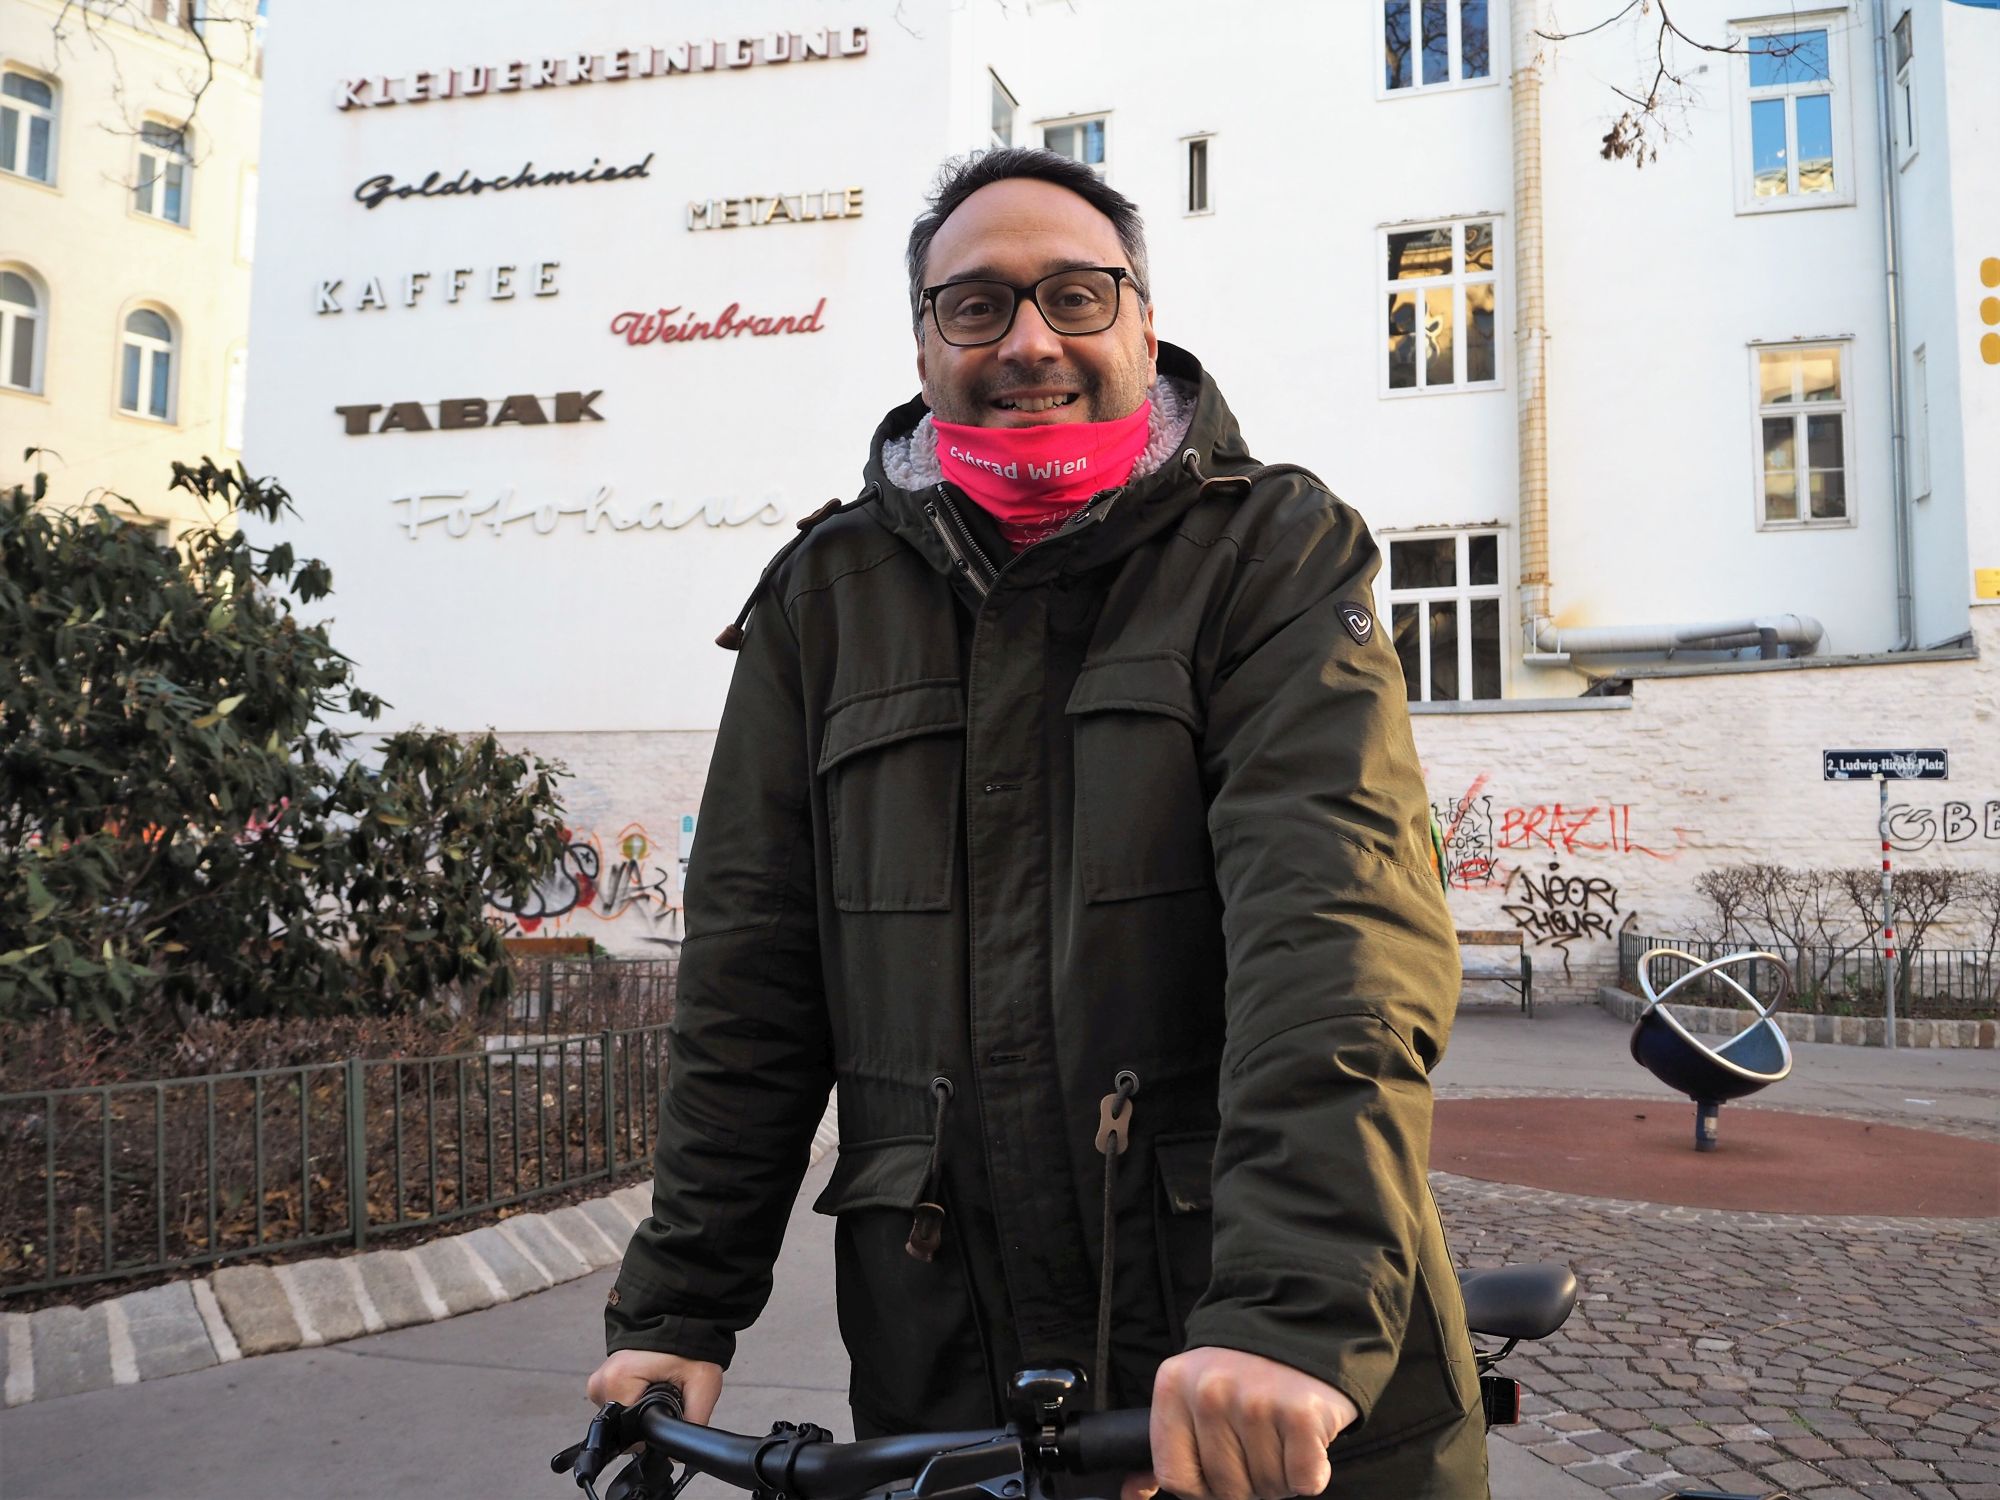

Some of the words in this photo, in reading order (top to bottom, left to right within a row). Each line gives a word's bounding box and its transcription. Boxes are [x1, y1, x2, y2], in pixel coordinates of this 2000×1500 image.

[337, 26, 868, 110] KLEIDERREINIGUNG
[355, 152, 655, 209] Goldschmied
[687, 186, 863, 232] METALLE
[315, 261, 560, 315] KAFFEE
[610, 297, 827, 346] Weinbrand
[335, 390, 605, 435] TABAK
[1027, 456, 1087, 480] Wien
[392, 484, 788, 540] Fotohaus
[1447, 835, 1487, 849] COPS
[1498, 803, 1677, 860] BRAZIL
